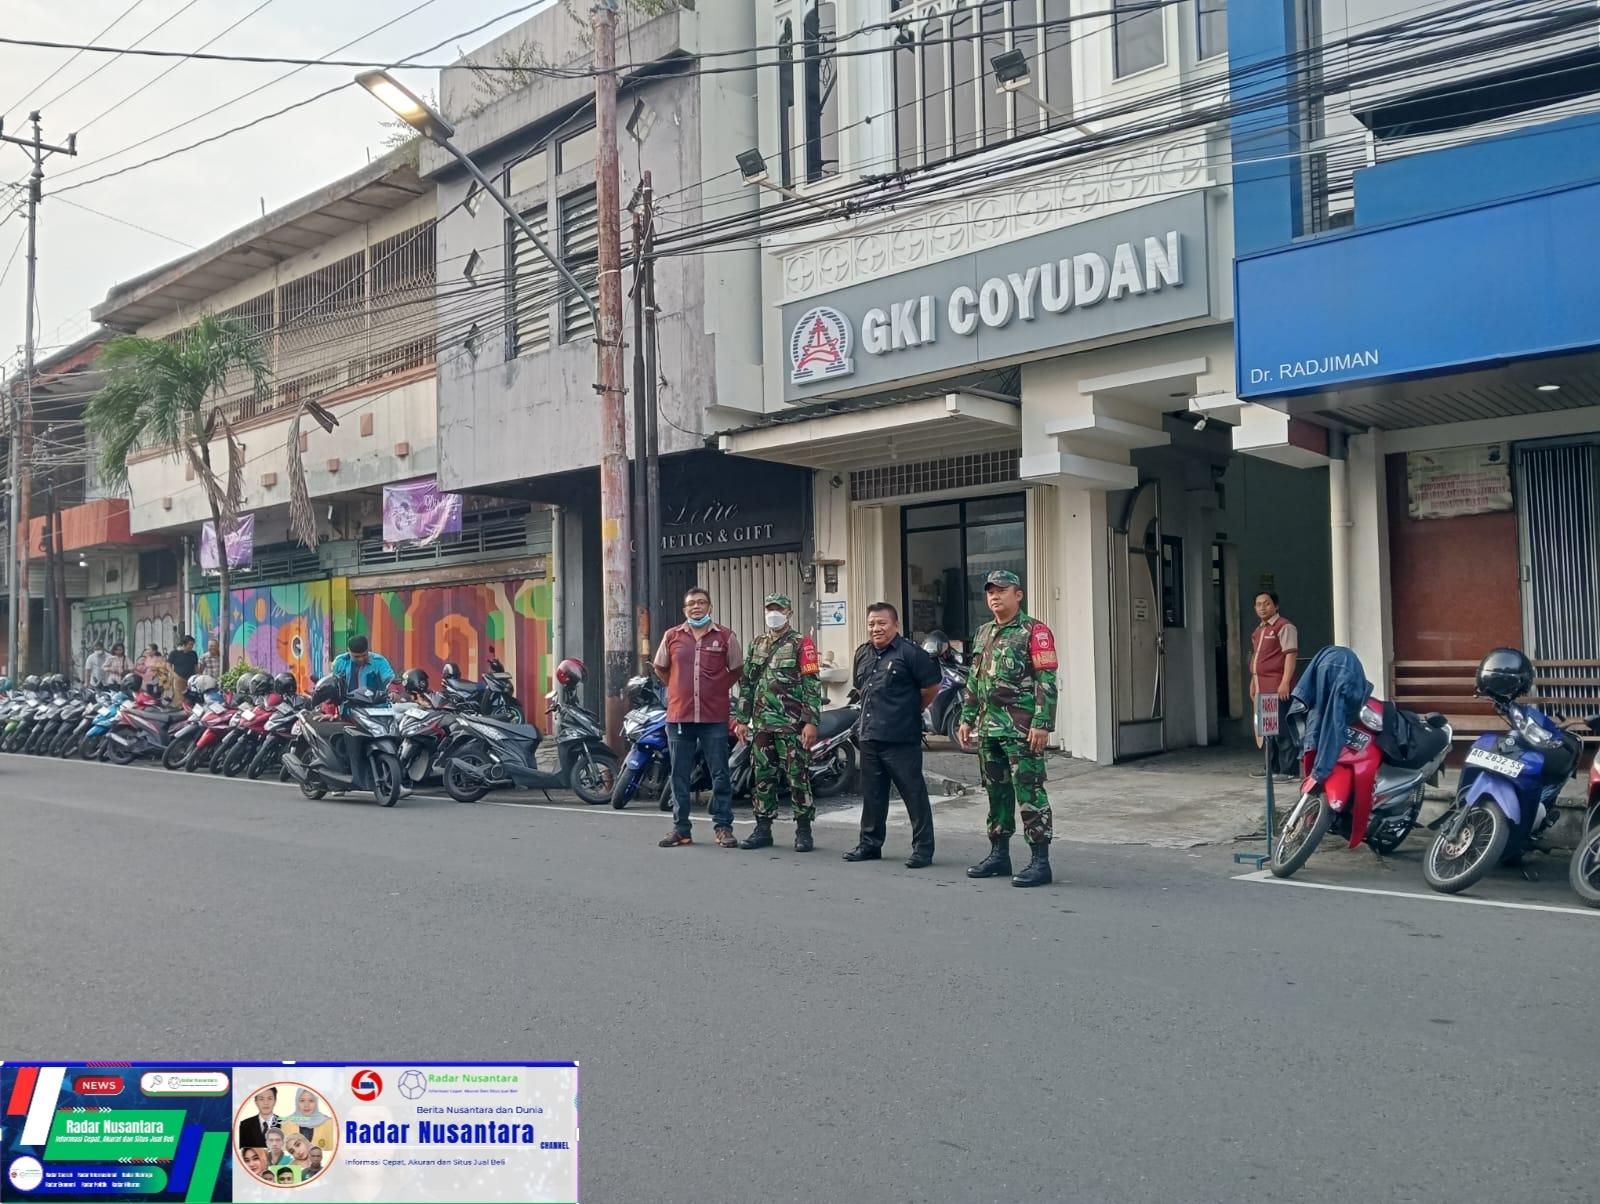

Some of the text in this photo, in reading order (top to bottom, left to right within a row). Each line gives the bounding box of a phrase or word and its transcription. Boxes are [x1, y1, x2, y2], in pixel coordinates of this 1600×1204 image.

[861, 230, 1184, 356] GKI COYUDAN
[1250, 348, 1380, 385] Dr. RADJIMAN
[717, 528, 729, 543] &
[733, 523, 775, 542] GIFT
